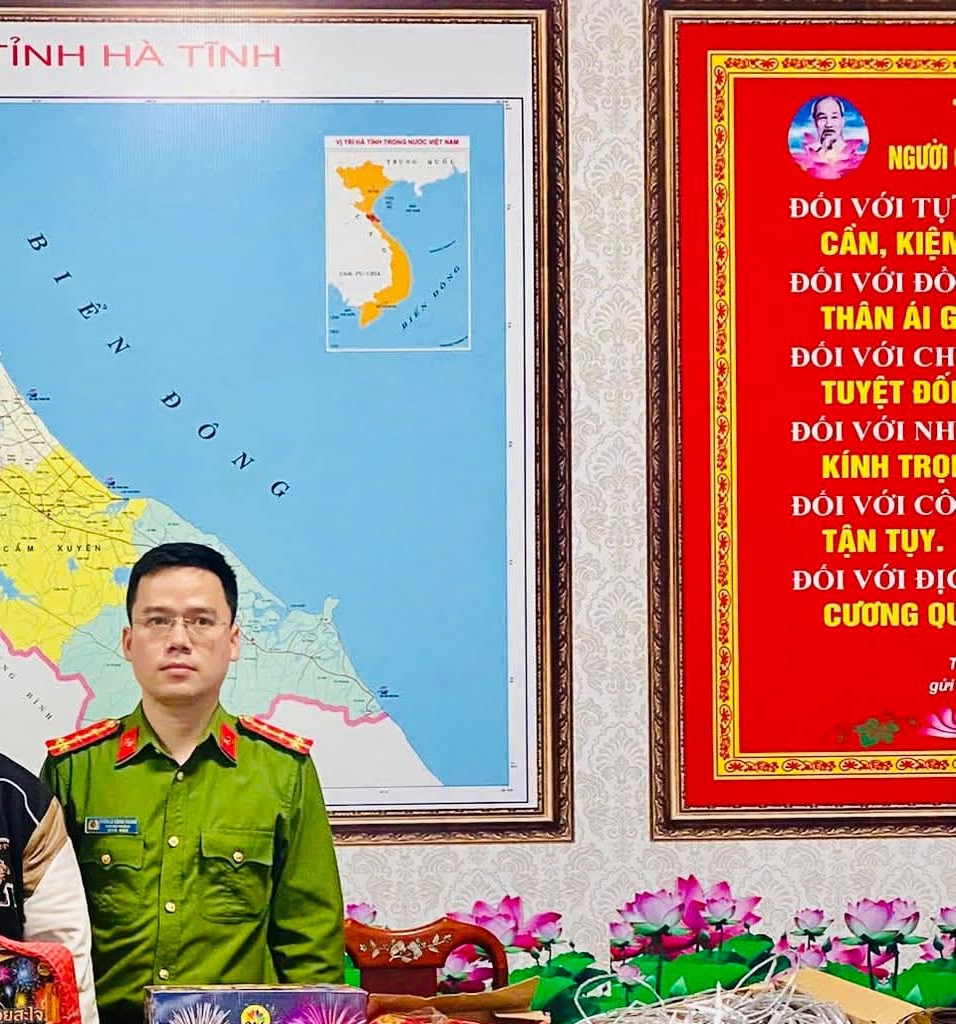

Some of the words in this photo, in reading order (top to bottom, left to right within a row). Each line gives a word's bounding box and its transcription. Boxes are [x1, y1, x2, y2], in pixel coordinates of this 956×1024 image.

[103, 39, 163, 67] HÀ
[177, 39, 282, 67] TĨNH
[889, 139, 948, 170] NGƯỜI
[789, 192, 843, 219] ĐỐI
[851, 192, 904, 219] VỚI
[912, 196, 956, 224] TỰ
[820, 223, 887, 258] CẦN,
[789, 267, 843, 293] ĐỐI
[852, 267, 904, 293] VỚI
[820, 301, 893, 330] THÂN
[903, 301, 931, 330] ÁI
[27, 233, 132, 354] BIỂN
[160, 390, 290, 498] ĐÔNG
[790, 341, 843, 368] ĐỐI
[852, 341, 904, 368] VỚI
[821, 375, 904, 410] TUYỆT
[791, 415, 844, 442] ĐỐI
[852, 415, 906, 442] VỚI
[822, 450, 889, 479] KÍNH
[897, 455, 956, 484] TRỌ
[791, 490, 845, 517] ĐỐI
[852, 489, 906, 517] VỚI
[913, 488, 956, 516] CÔ
[57, 543, 101, 552] XUYÊN
[822, 524, 877, 559] TẬN
[886, 528, 945, 558] TỤY.
[793, 564, 845, 591] ĐỐI
[853, 563, 906, 591] VỚI
[824, 600, 919, 628] CƯƠNG
[929, 677, 954, 695] gửi
